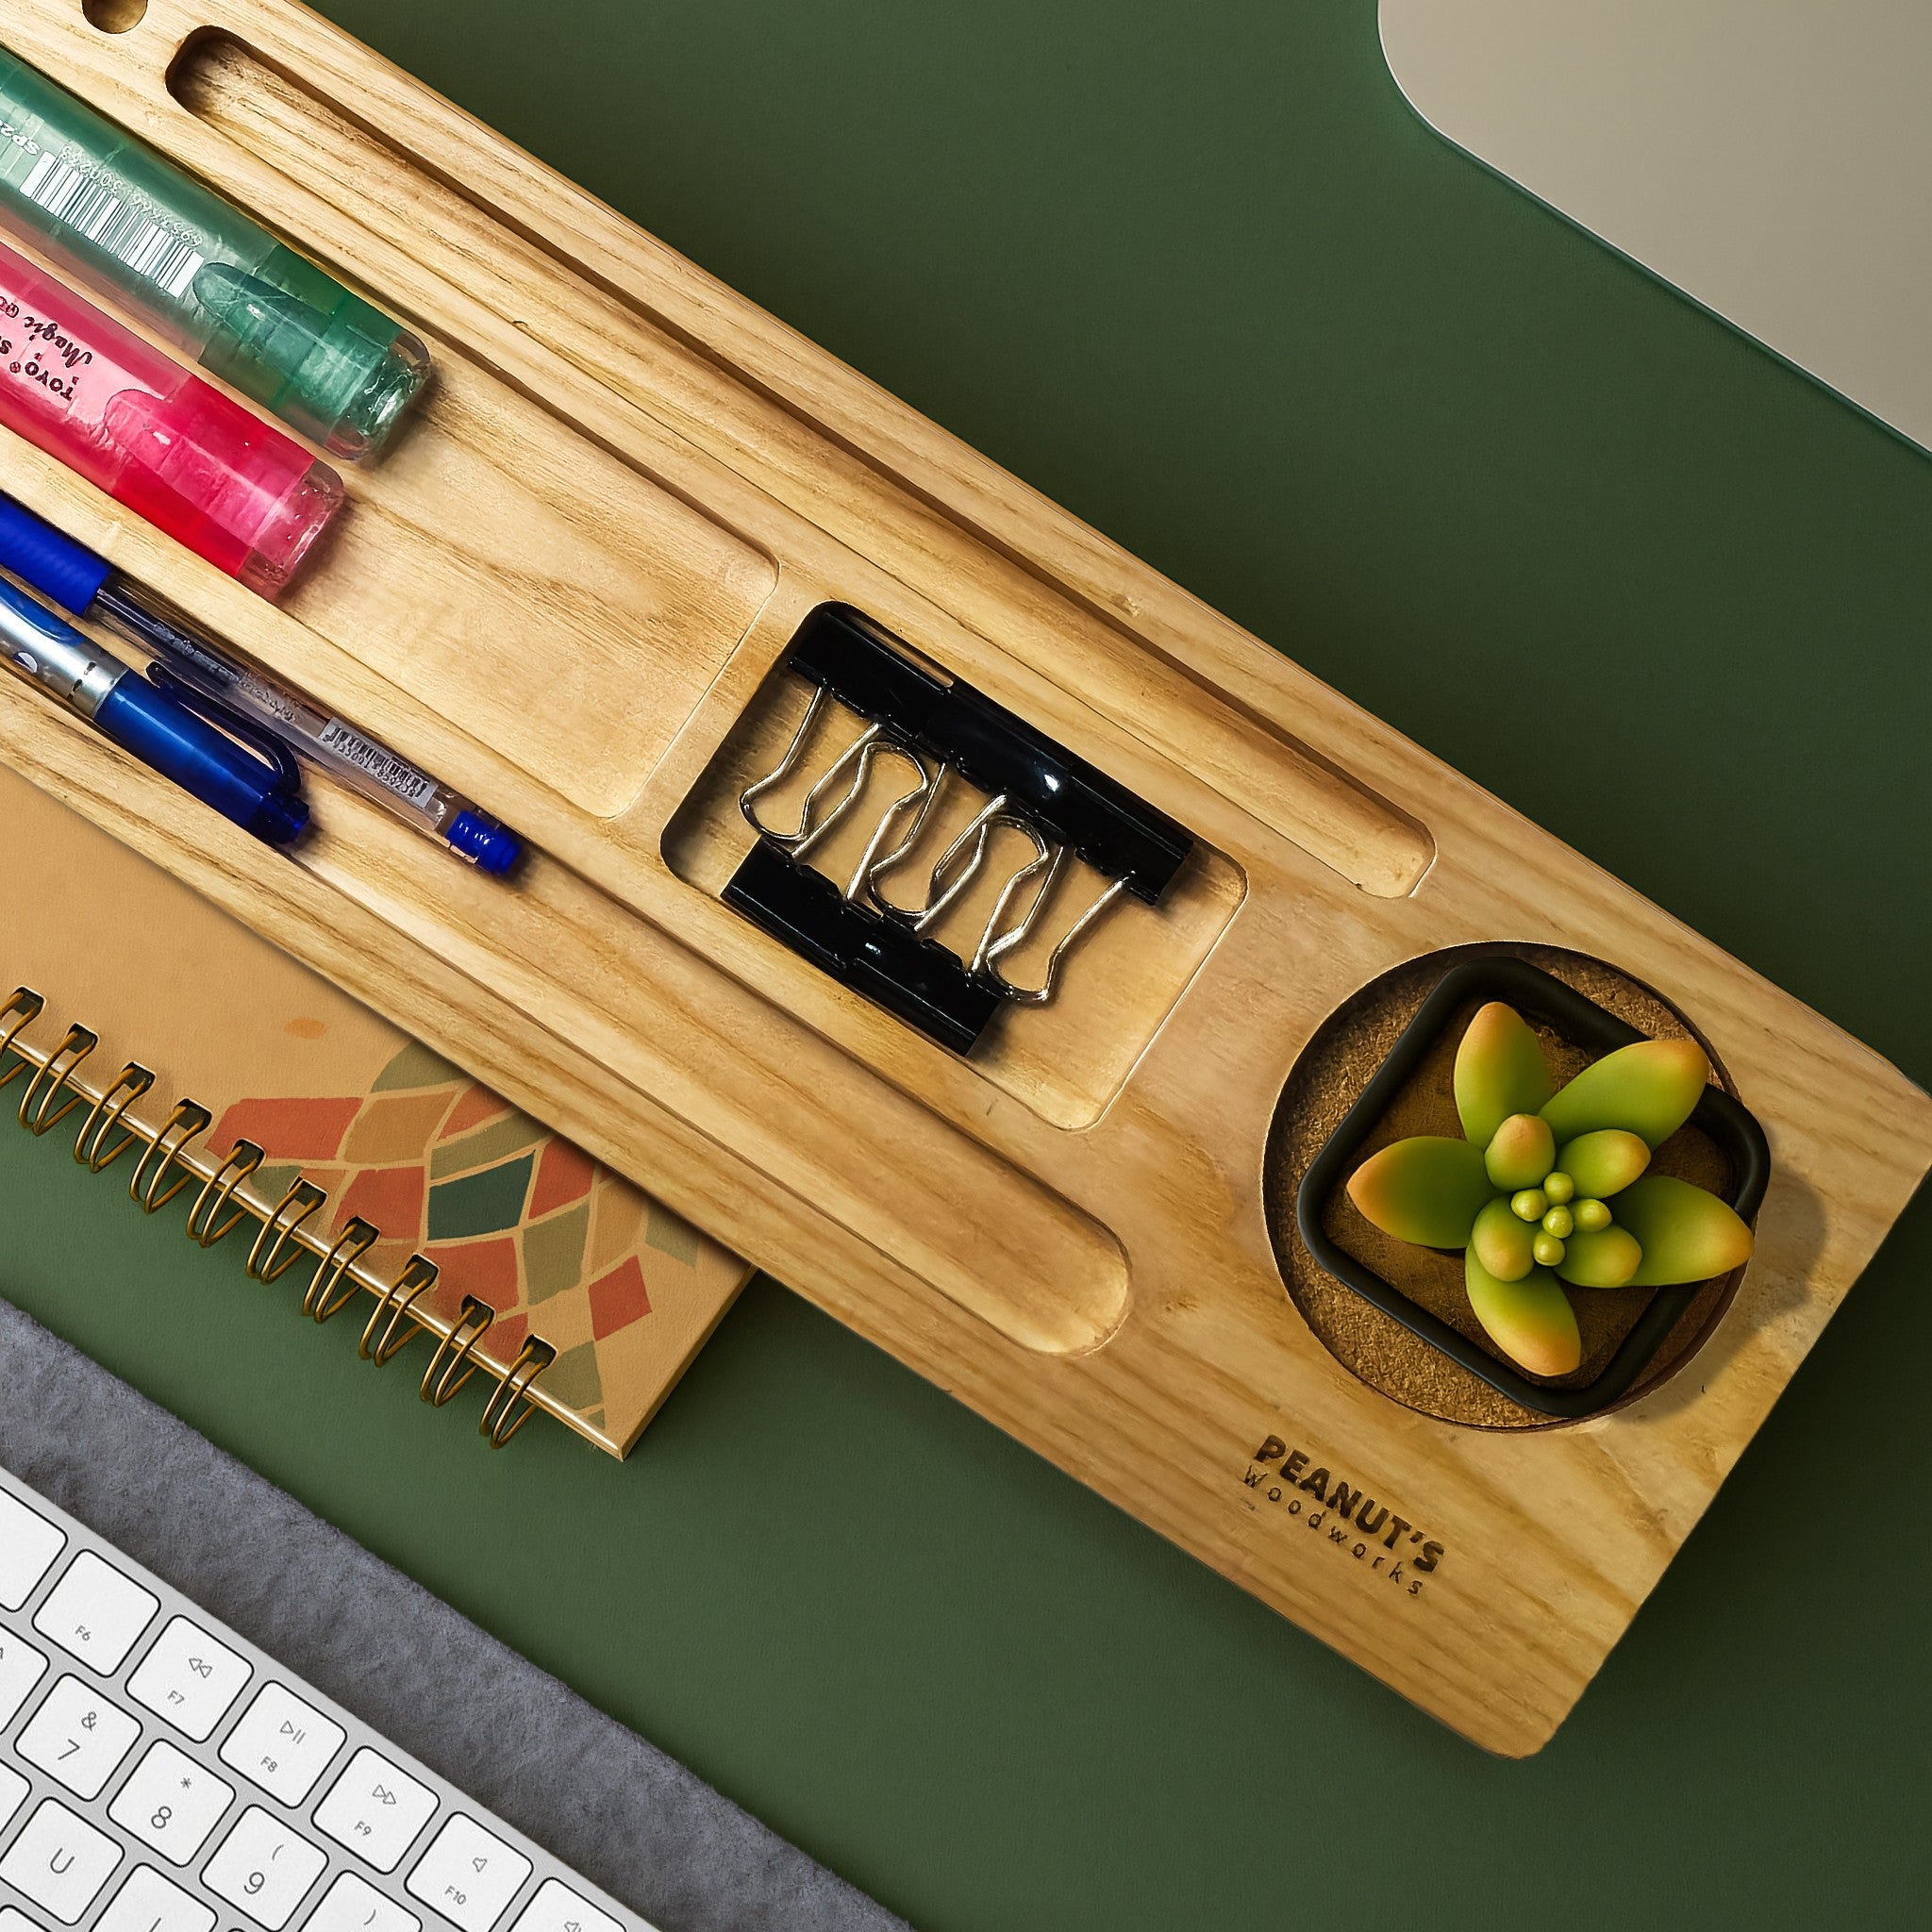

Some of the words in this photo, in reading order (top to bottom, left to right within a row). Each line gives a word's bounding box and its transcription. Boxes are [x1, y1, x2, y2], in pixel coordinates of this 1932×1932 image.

[0, 119, 40, 156] SP2
[24, 316, 92, 368] Magic
[1254, 1434, 1445, 1573] PEANUT'S
[1242, 1464, 1424, 1596] Woodworks
[75, 1625, 92, 1641] F6
[167, 1690, 185, 1705] F7
[58, 1738, 81, 1760] 7
[260, 1756, 278, 1773] F8
[151, 1806, 173, 1829] 8
[354, 1821, 372, 1837] F9
[50, 1847, 75, 1874] U
[243, 1872, 265, 1894] 9
[444, 1885, 467, 1906] F10
